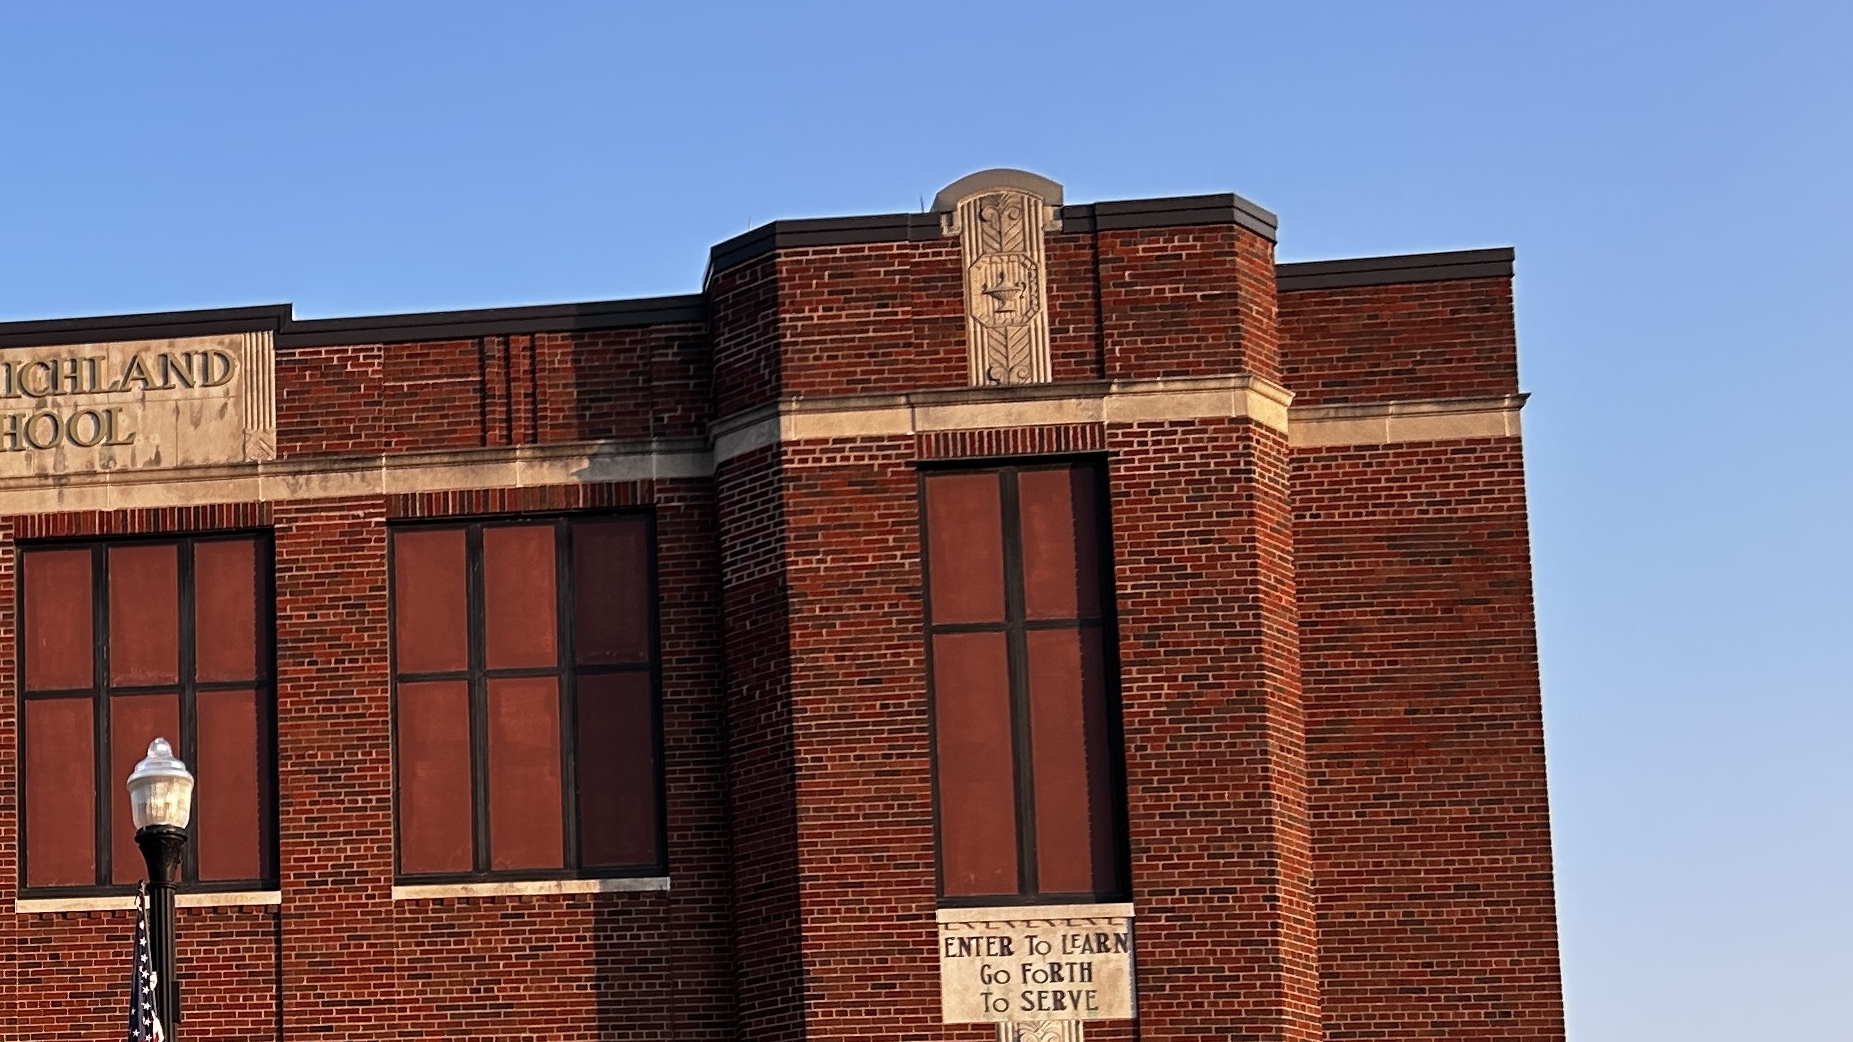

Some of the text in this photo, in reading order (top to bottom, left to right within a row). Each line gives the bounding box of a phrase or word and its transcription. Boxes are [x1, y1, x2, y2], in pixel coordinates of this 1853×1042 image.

[944, 935, 1015, 958] ENTER
[1061, 932, 1130, 955] LEARN
[1021, 961, 1093, 984] FORTH
[1020, 989, 1099, 1012] SERVE
